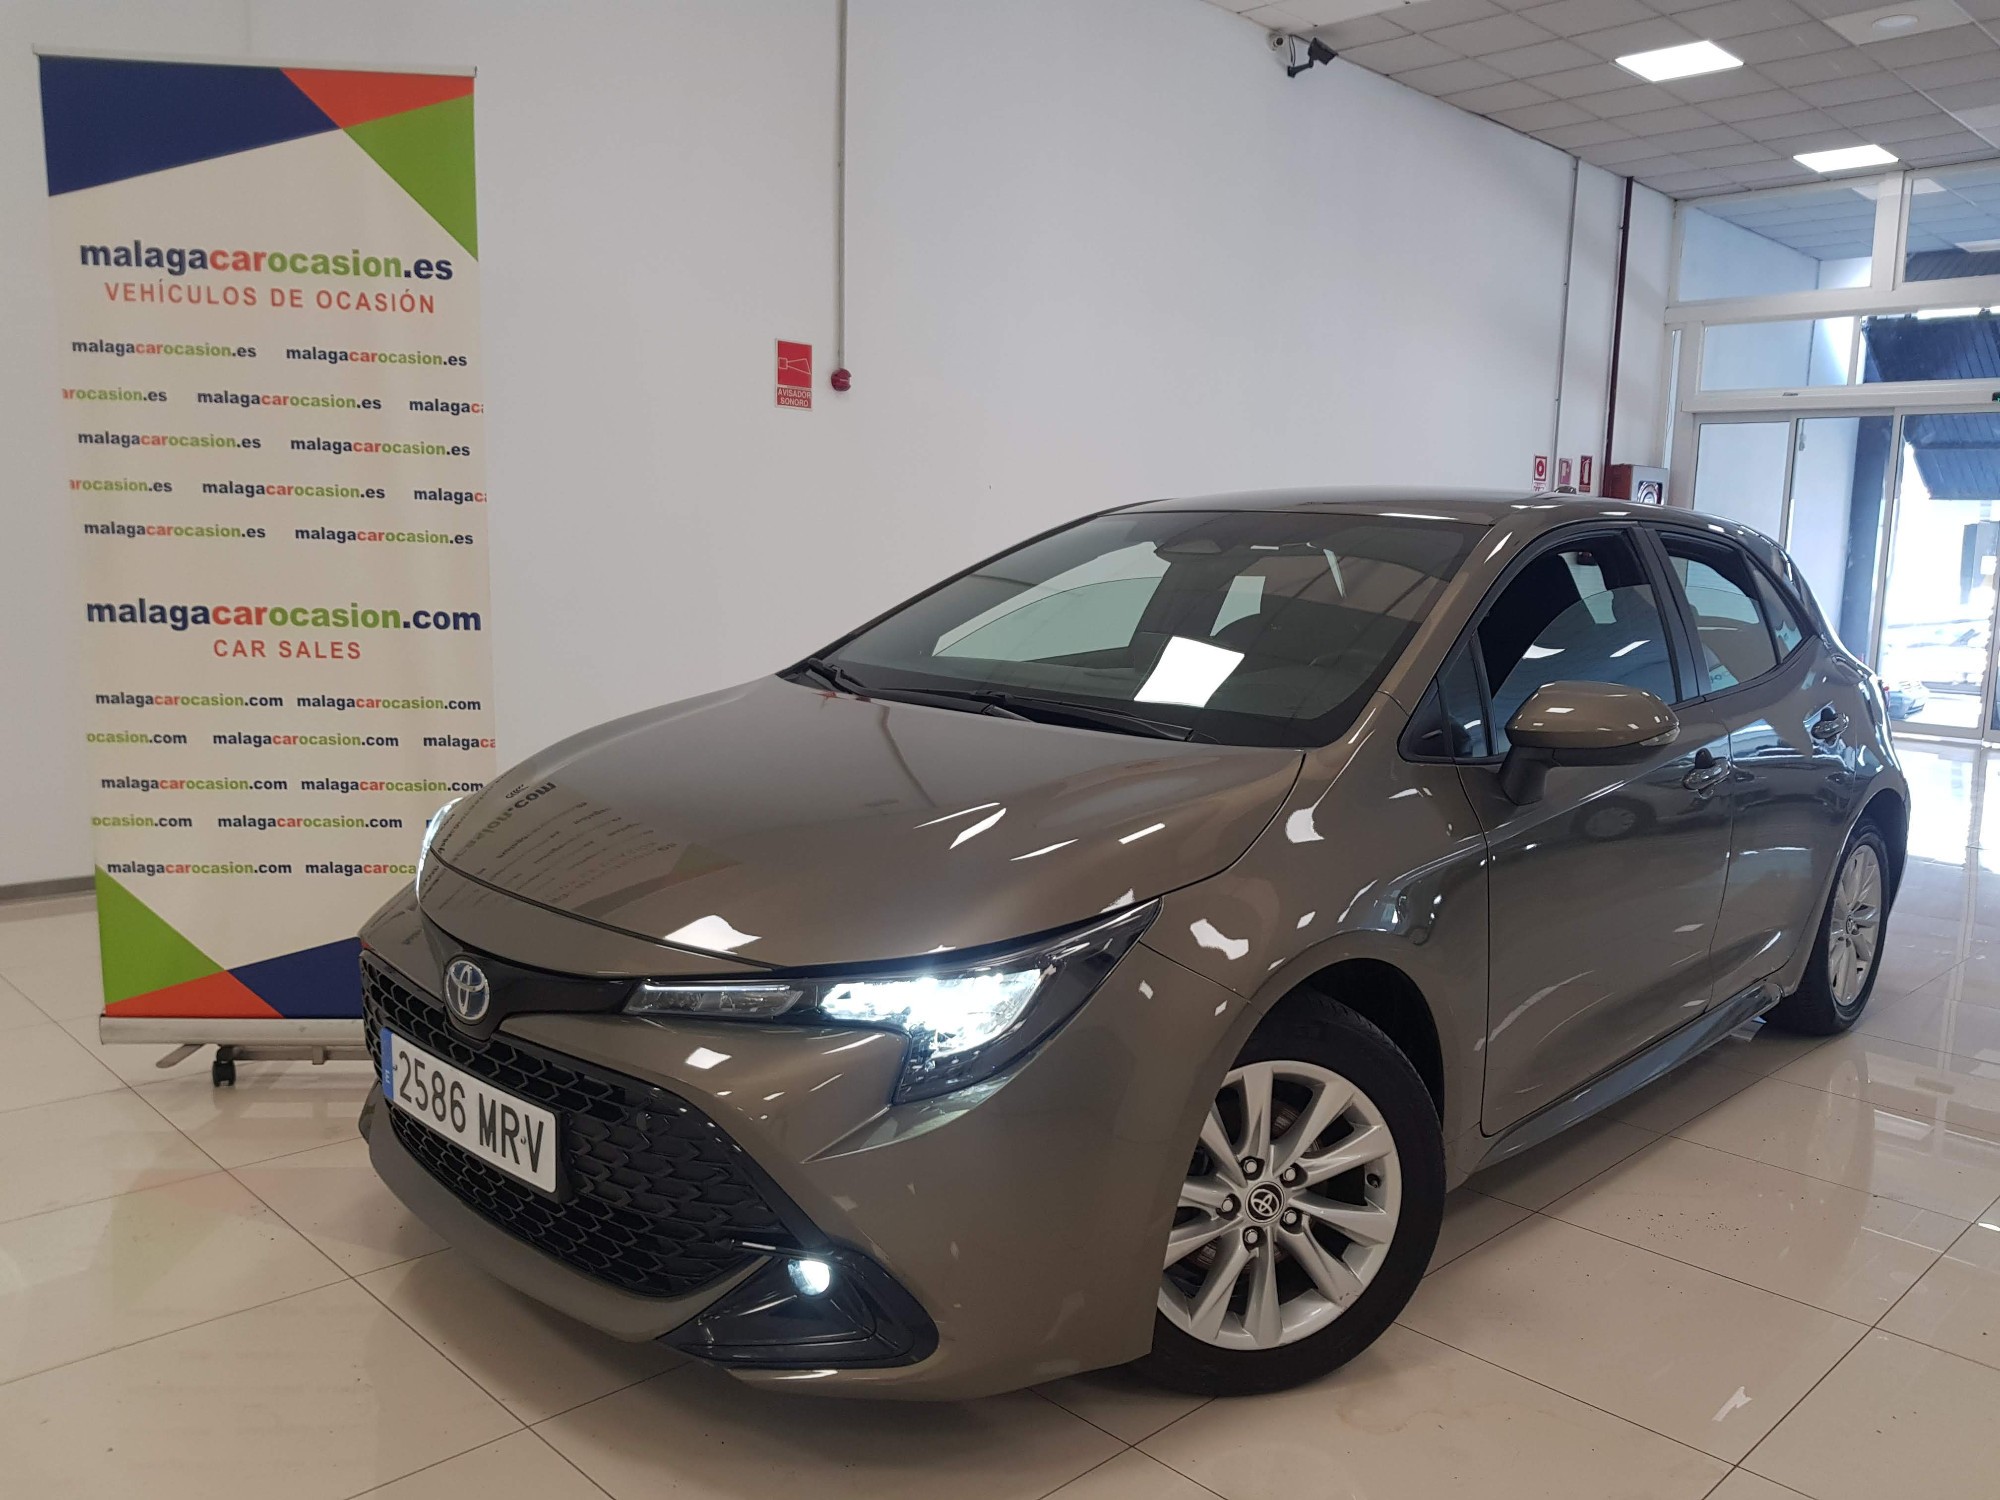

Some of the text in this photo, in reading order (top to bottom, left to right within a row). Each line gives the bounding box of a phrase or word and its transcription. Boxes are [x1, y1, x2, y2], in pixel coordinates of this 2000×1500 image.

[80, 241, 453, 280] malagacarocasion.es
[105, 279, 434, 314] VEHÍCULOS DE OCASIÓN
[72, 339, 257, 358] malagacarocasion.es
[286, 346, 468, 367] malagacarocasion.es
[197, 390, 382, 410] malagacarocasion.es
[778, 388, 811, 398] AVISADOR
[780, 398, 809, 407] SONORO
[78, 430, 262, 449] malagacarocasion.es
[290, 437, 471, 457] malagacarocasion.es
[202, 480, 386, 499] malagacarocasion.es
[84, 521, 266, 539] malagacarocasion.es
[294, 526, 474, 545] malagacarocasion.es
[86, 597, 482, 631] malagacarocasion.com
[213, 639, 362, 660] CAR SALES
[95, 691, 284, 709] malagacarocasion.com
[296, 694, 482, 711] malagacarocasion.com
[212, 732, 400, 748] malagacarocasion.com
[101, 776, 288, 792] malagacarocasion.com
[217, 815, 403, 830] malagacarocasion.com
[107, 860, 292, 876] malagacarocasion.com
[399, 1050, 544, 1173] 2586 MRV
